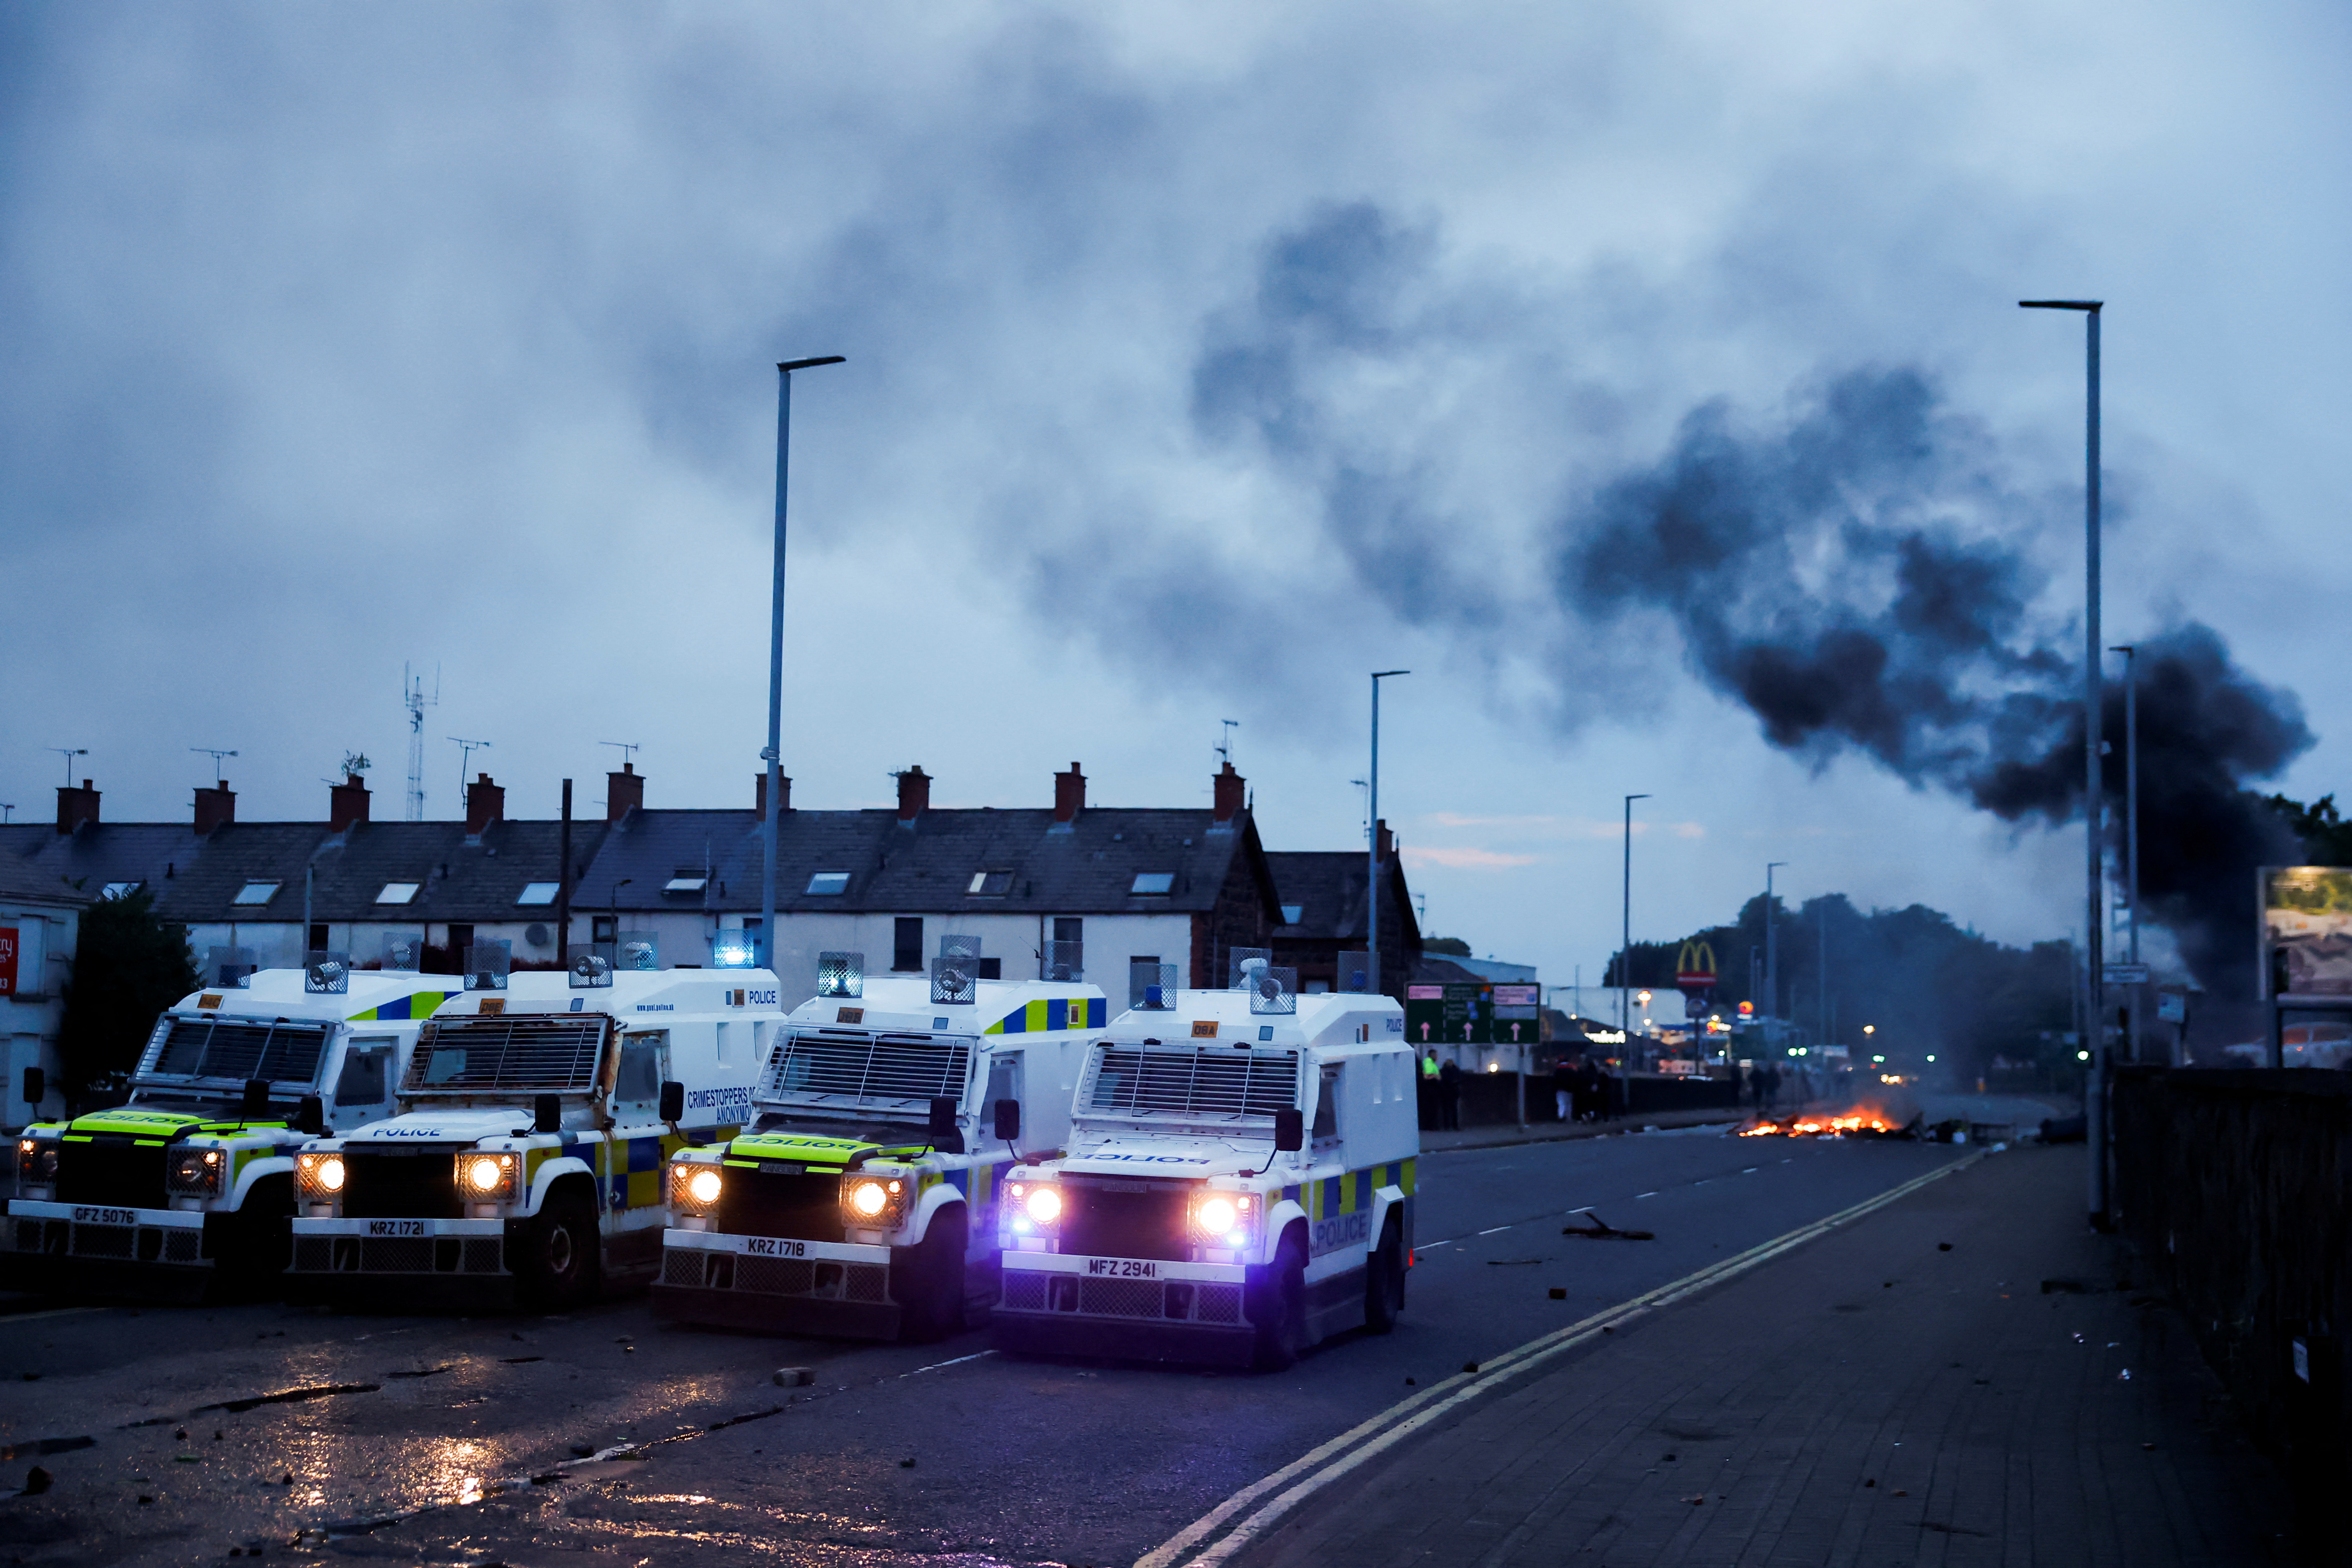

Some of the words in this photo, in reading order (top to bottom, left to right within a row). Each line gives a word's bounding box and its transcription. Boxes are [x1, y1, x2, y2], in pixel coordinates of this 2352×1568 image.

[0, 939, 12, 957] ry
[749, 990, 776, 1004] POLICE
[1386, 1019, 1402, 1032] POLICE
[688, 1087, 747, 1109] CRIMESTOPPERS
[76, 1208, 99, 1222] GFZ
[103, 1210, 134, 1224] 5076
[370, 1222, 396, 1235] KRZ
[400, 1222, 424, 1235] 1721
[1316, 1214, 1366, 1249] POLICE
[748, 1239, 775, 1254] KRZ
[779, 1241, 804, 1256] 1718
[1089, 1259, 1118, 1275] MFZ
[1123, 1261, 1155, 1277] 2941
